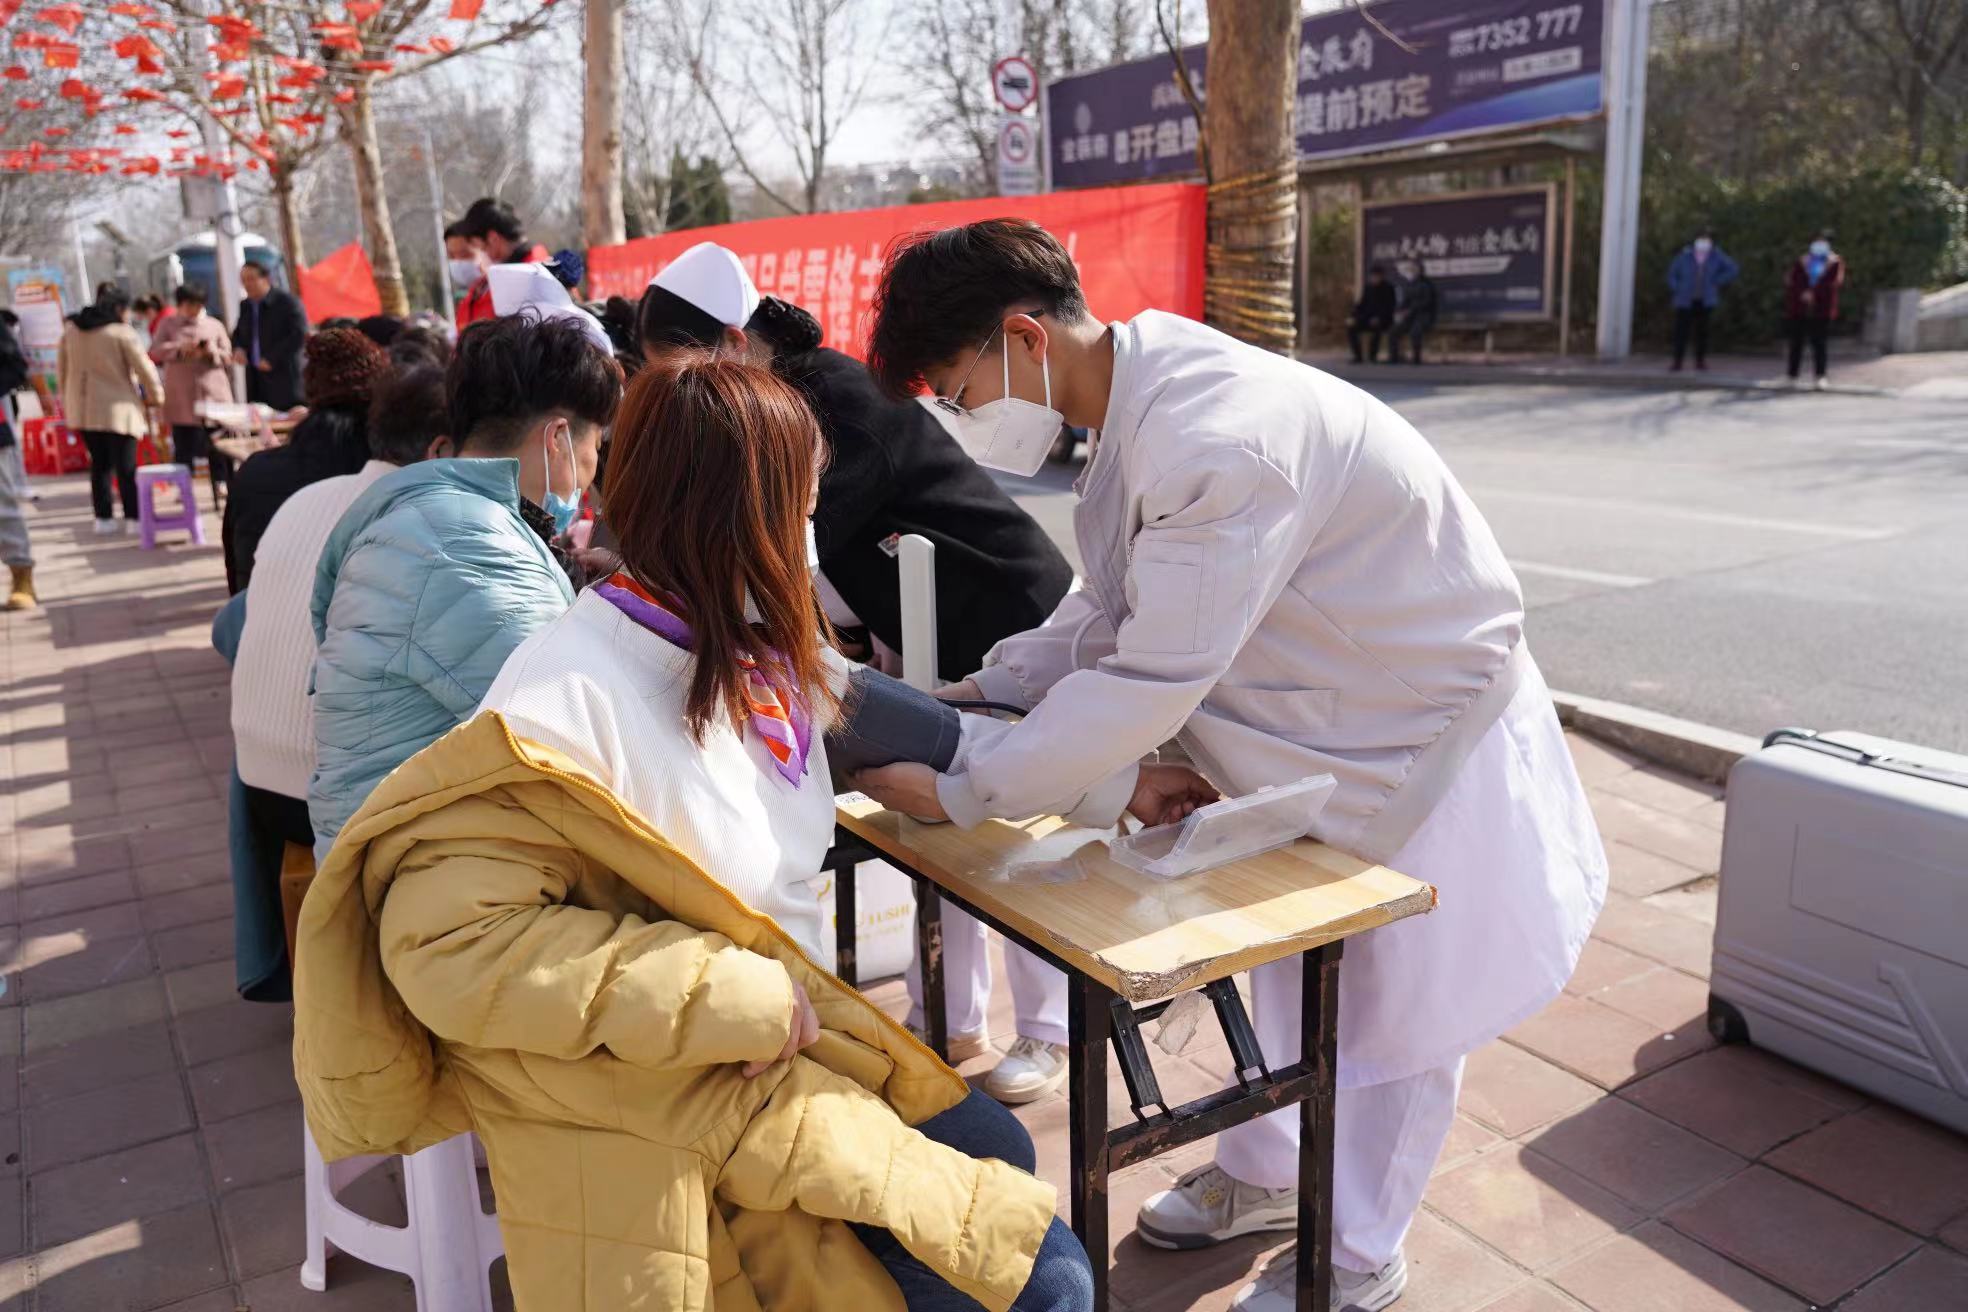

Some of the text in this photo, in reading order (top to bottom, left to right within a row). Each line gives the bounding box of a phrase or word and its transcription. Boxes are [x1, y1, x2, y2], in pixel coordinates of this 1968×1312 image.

[1536, 4, 1583, 40] 777
[1295, 72, 1432, 136] 提前预定
